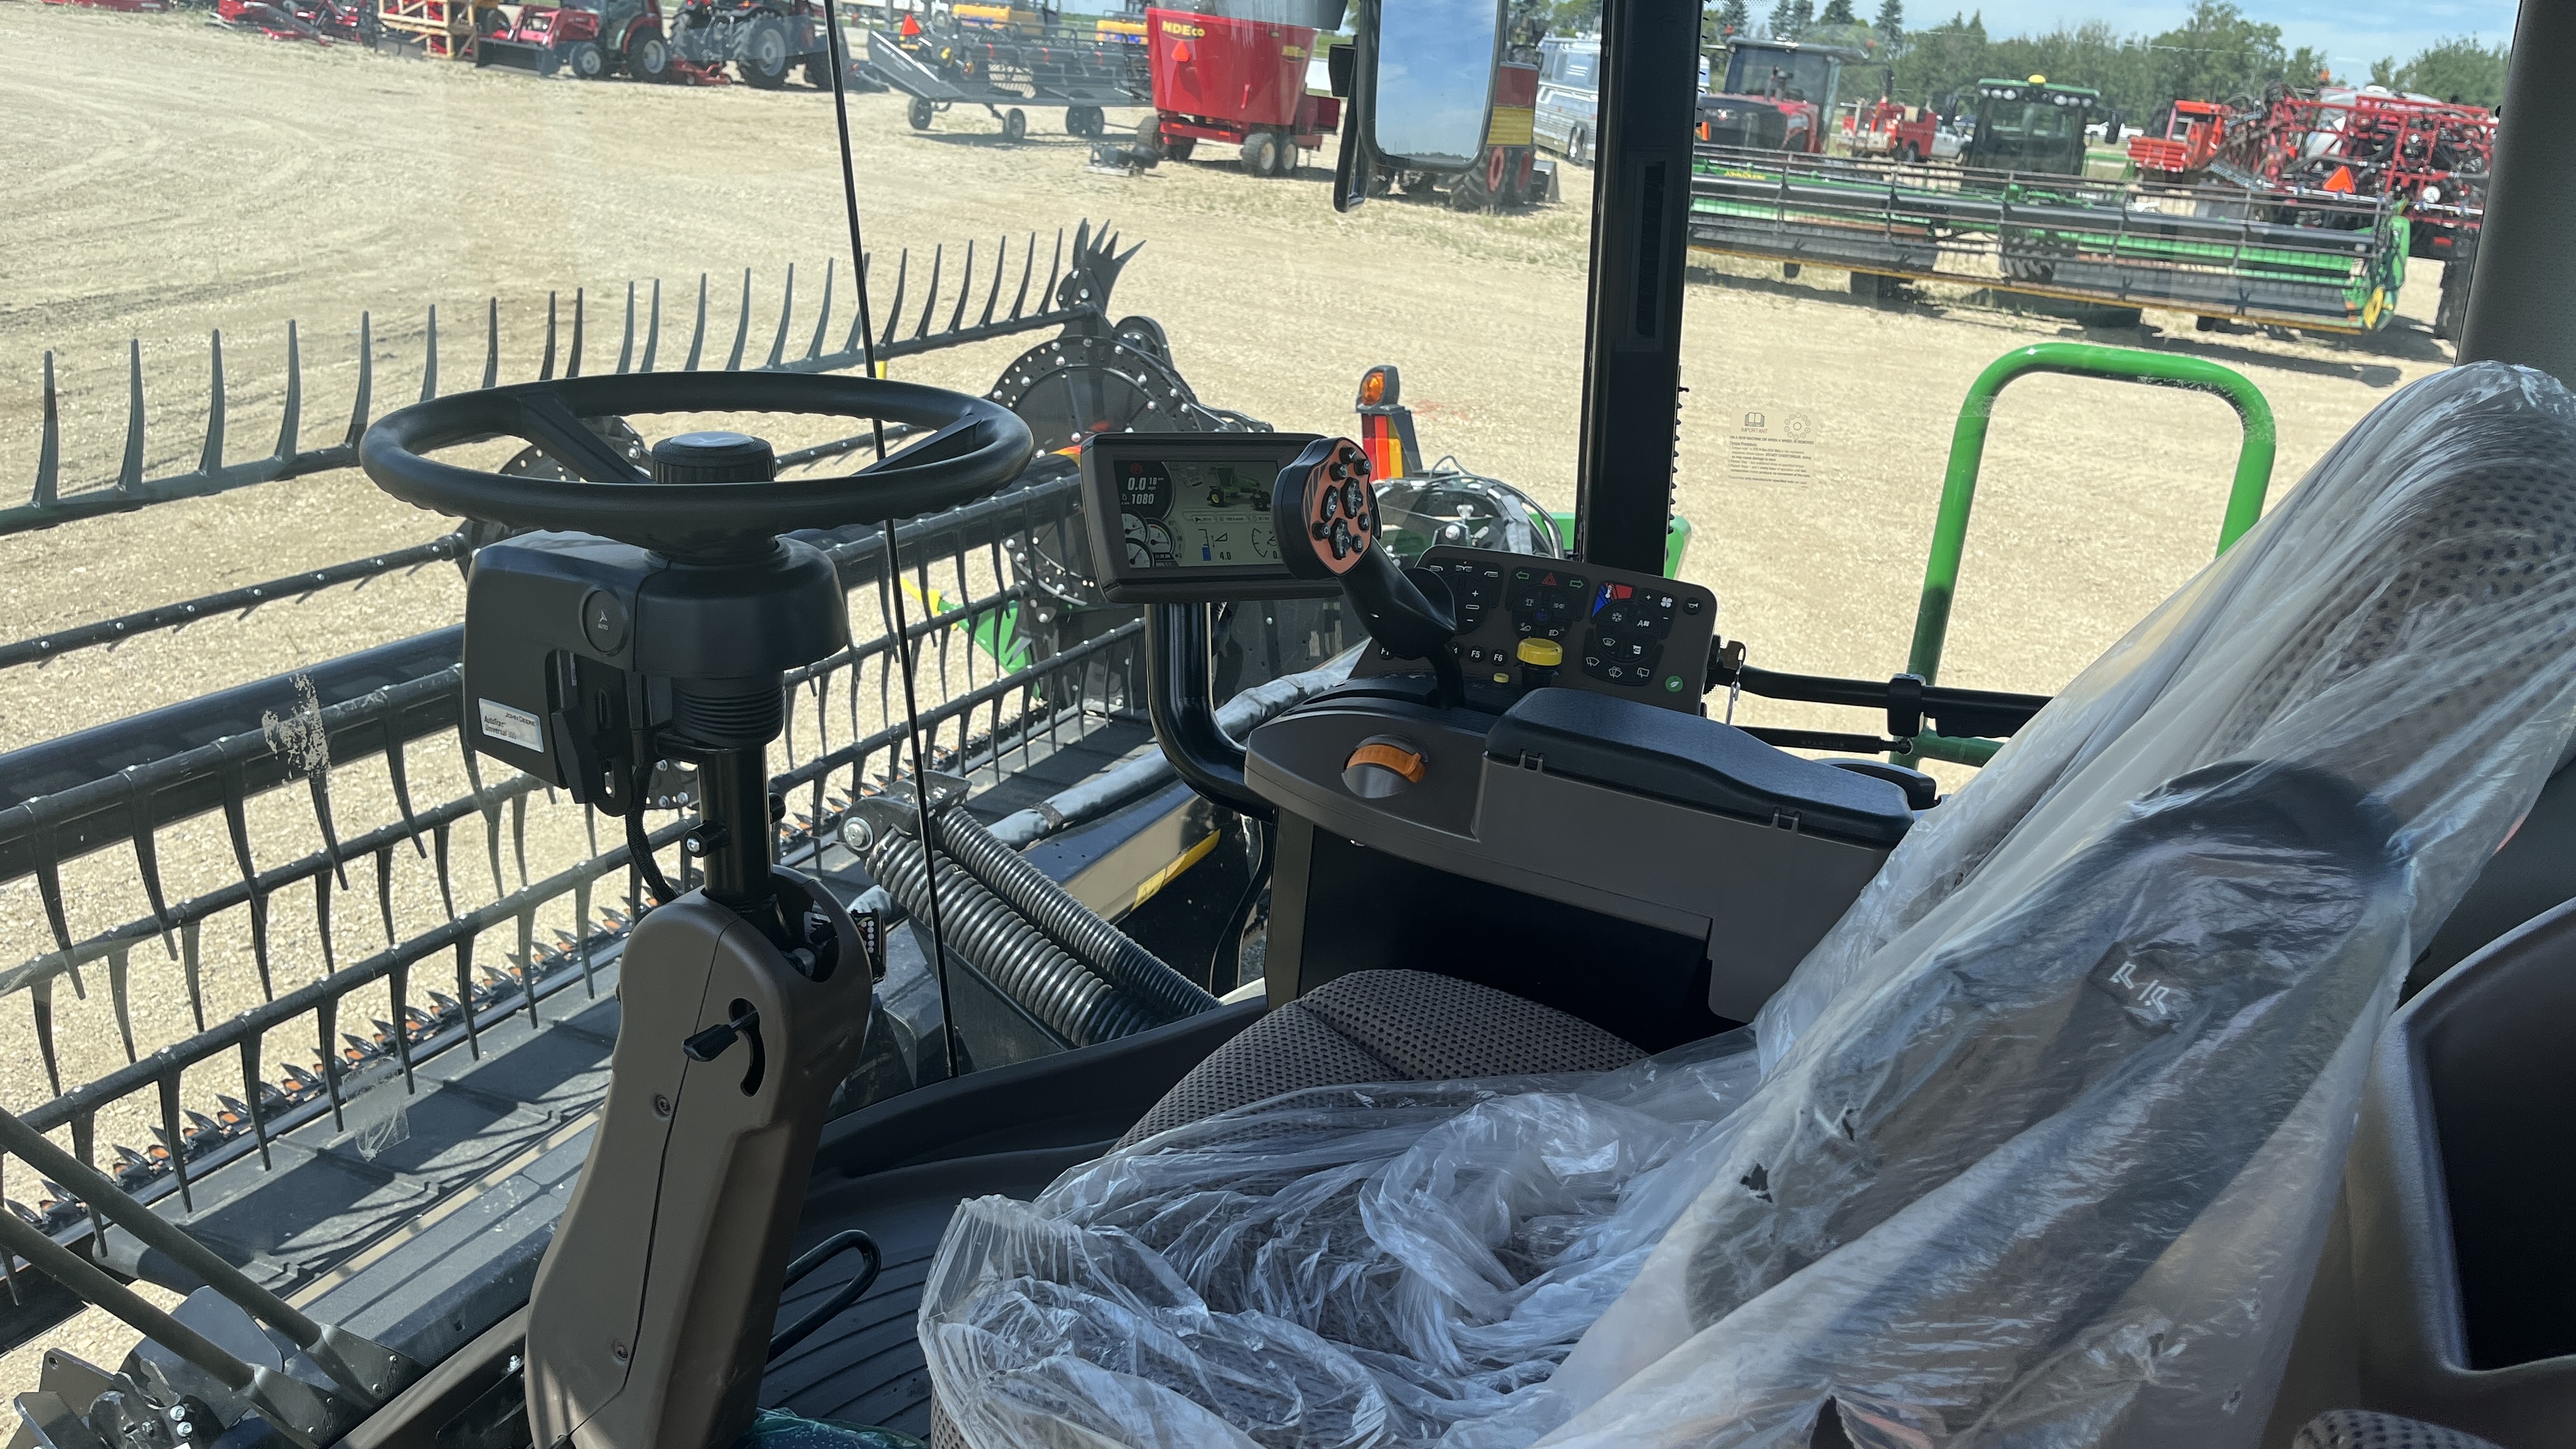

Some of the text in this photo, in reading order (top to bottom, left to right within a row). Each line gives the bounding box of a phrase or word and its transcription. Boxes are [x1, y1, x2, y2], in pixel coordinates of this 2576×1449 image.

[1128, 477, 1147, 491] 0.0
[1132, 493, 1154, 505] 1080
[1363, 518, 1368, 526] A
[1324, 526, 1329, 535] C
[1471, 650, 1480, 658] F5
[1494, 654, 1503, 662] F6
[505, 712, 535, 726] JOHN DEERE
[486, 724, 507, 736] Universal
